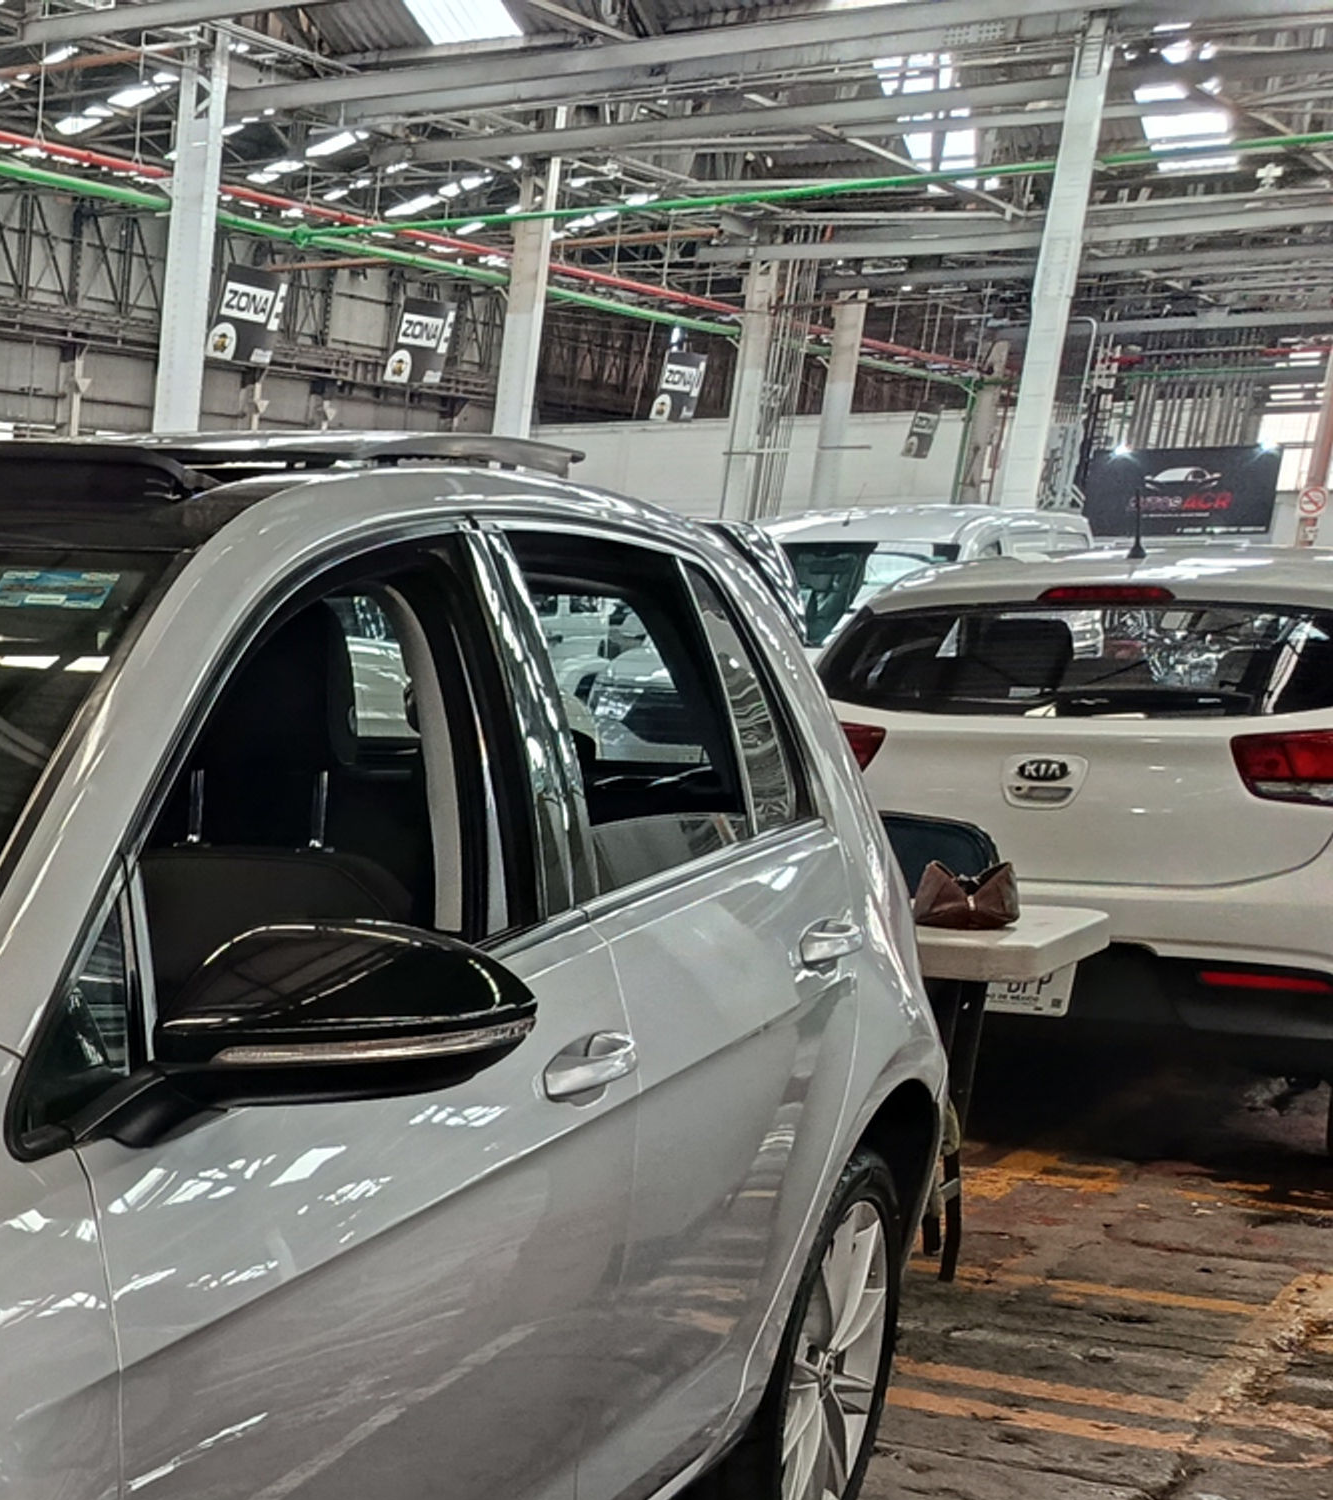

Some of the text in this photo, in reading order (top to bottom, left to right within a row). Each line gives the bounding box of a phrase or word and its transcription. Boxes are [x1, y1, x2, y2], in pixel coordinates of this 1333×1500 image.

[224, 289, 269, 316] ZONA
[401, 319, 441, 341] ZONA
[1183, 491, 1232, 511] ACR
[1024, 763, 1061, 777] KIA
